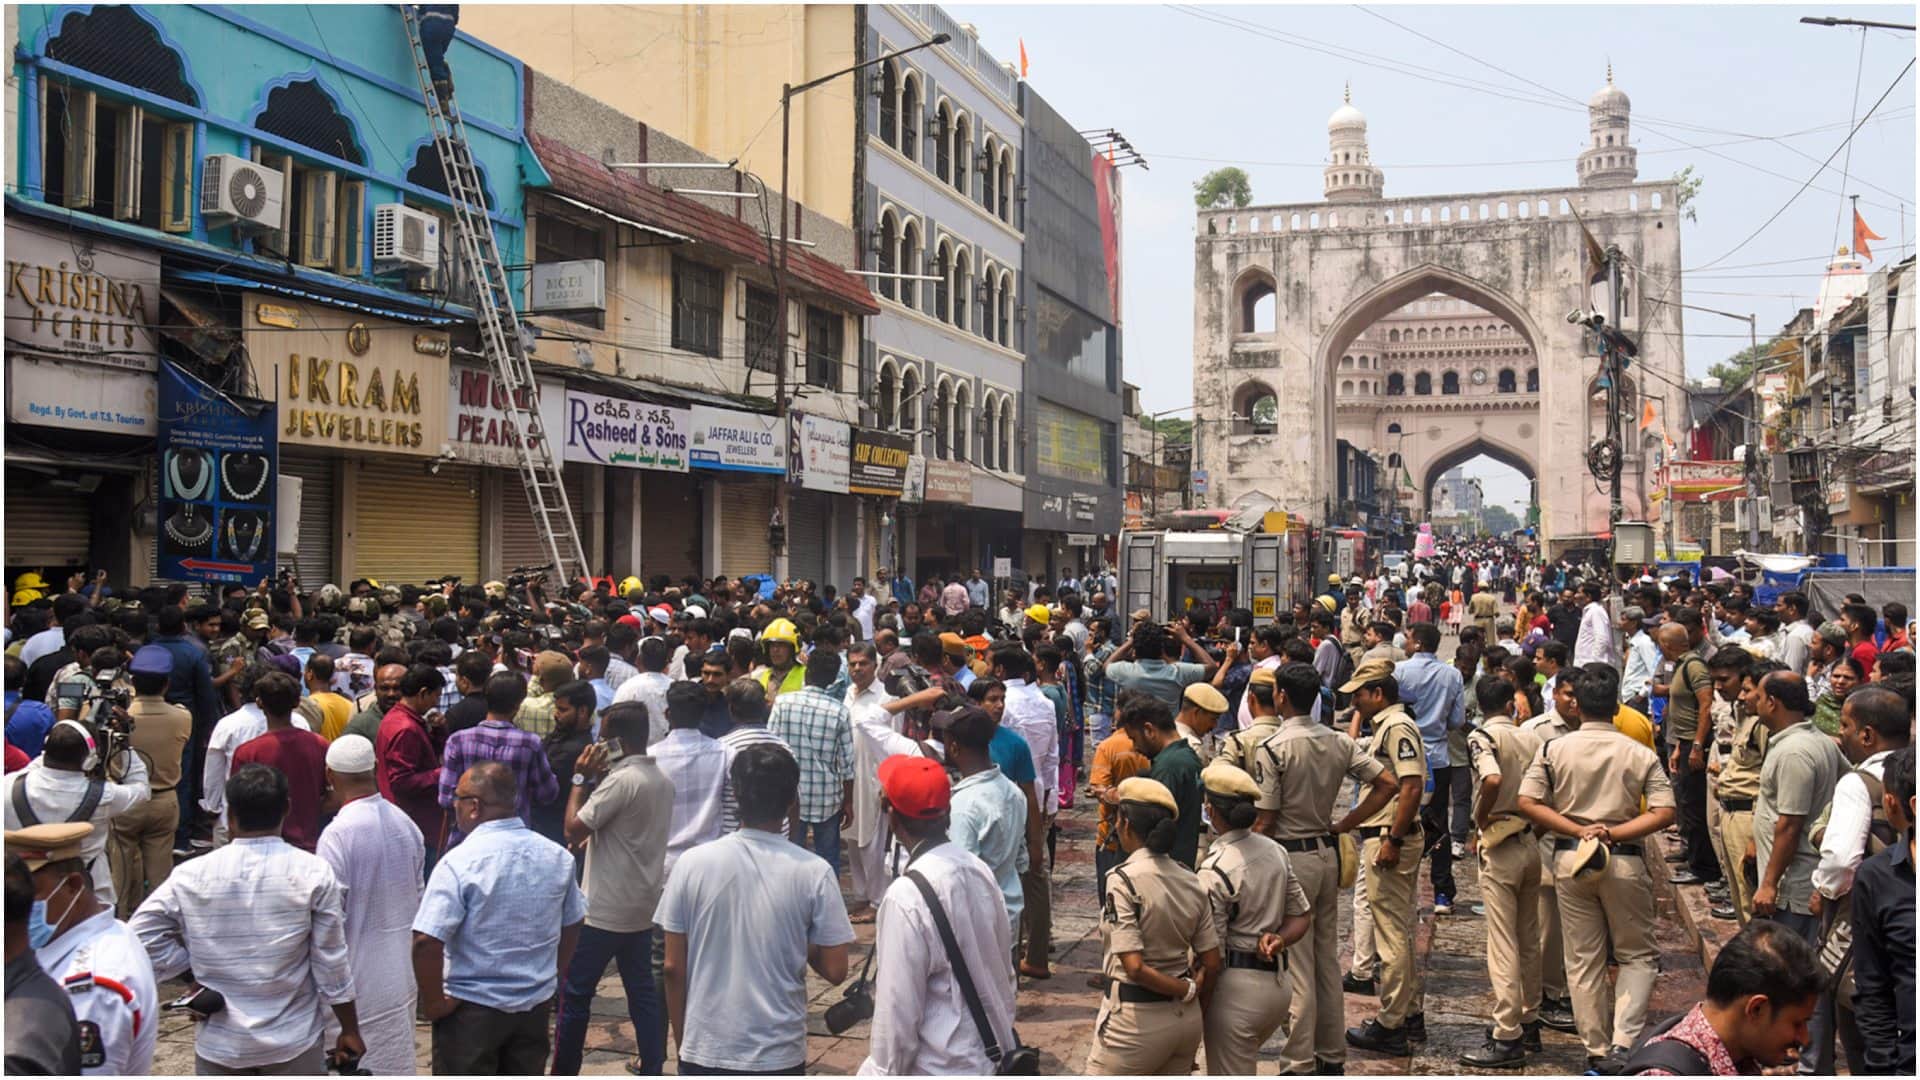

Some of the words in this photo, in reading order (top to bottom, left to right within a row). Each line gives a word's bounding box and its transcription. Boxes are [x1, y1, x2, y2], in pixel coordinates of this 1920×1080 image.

[289, 353, 421, 415] IKRAM
[29, 402, 53, 417] Regd.
[55, 406, 65, 419] By
[67, 408, 88, 420] Govt.
[90, 410, 99, 419] of
[100, 411, 114, 423] T.S.
[116, 413, 145, 425] Tourism
[593, 399, 631, 420] రషీద్
[635, 408, 643, 421] &
[286, 407, 423, 448] JEWELLERS
[567, 397, 637, 464] Rasheed
[641, 424, 651, 446] &
[656, 425, 687, 450] Sons
[707, 426, 738, 442] JAFFAR
[739, 430, 752, 443] ALI
[753, 432, 759, 444] &
[760, 433, 774, 446] CO.
[725, 444, 757, 456] JEWELLERS
